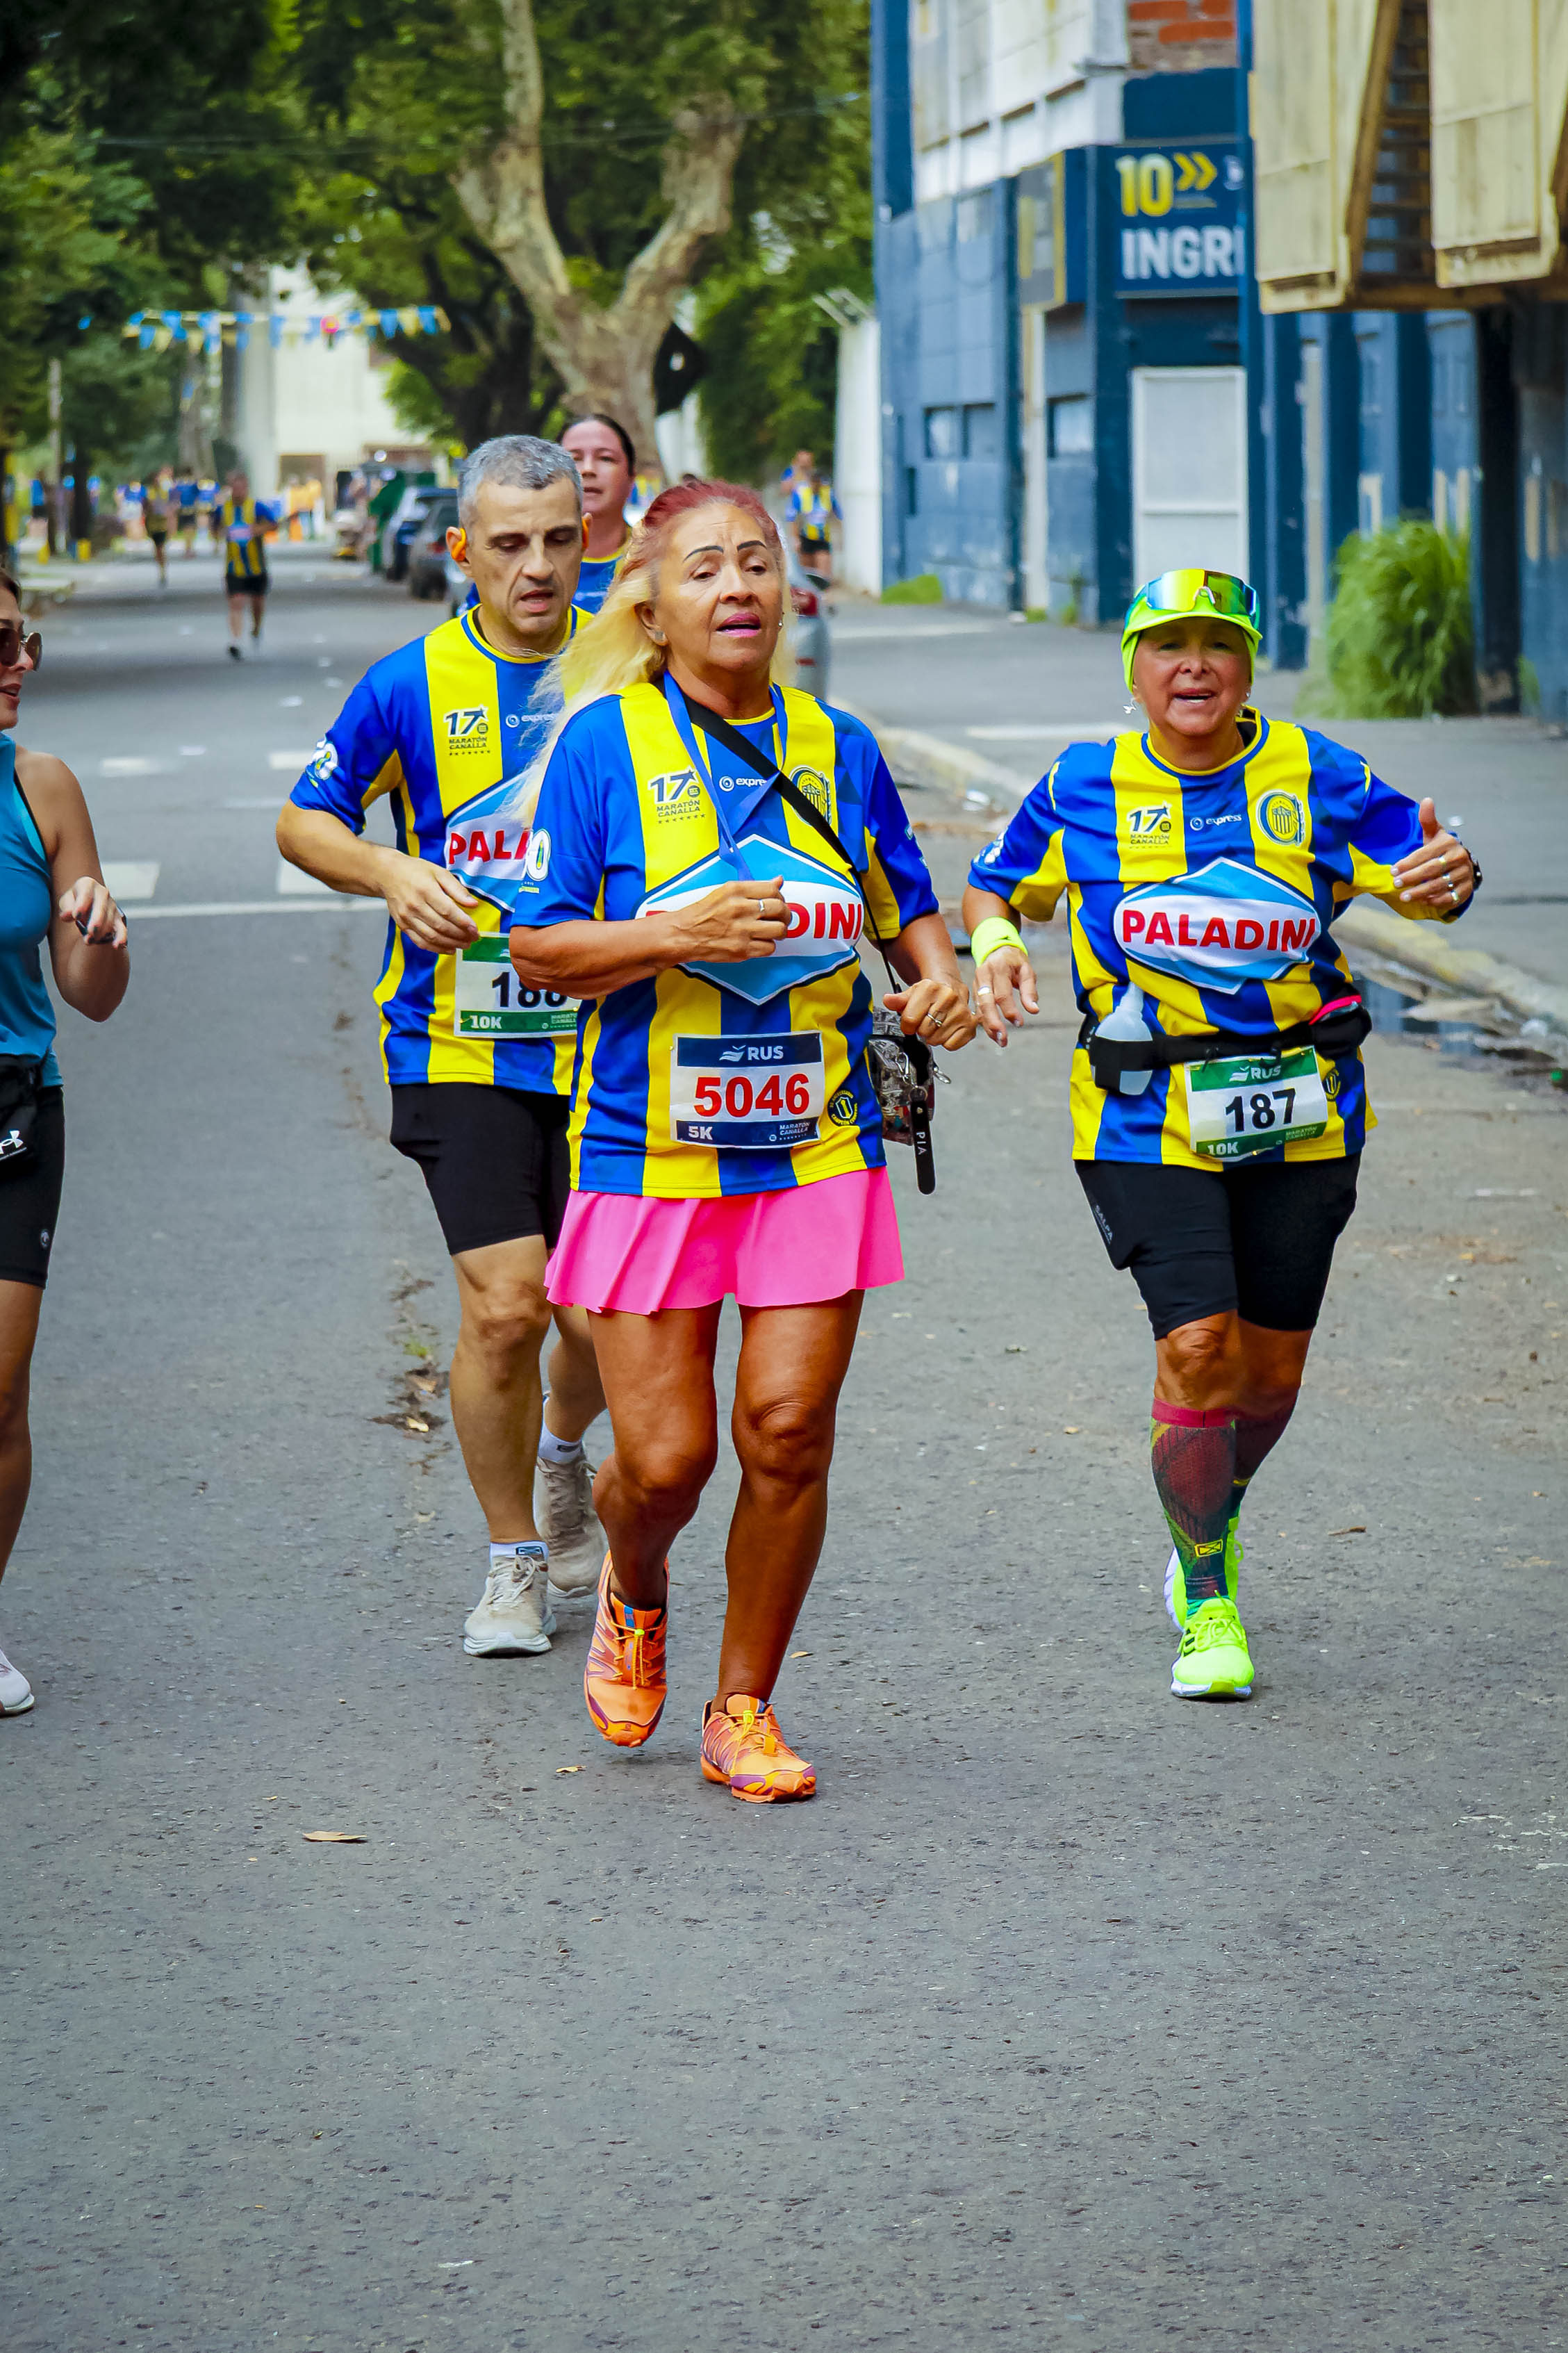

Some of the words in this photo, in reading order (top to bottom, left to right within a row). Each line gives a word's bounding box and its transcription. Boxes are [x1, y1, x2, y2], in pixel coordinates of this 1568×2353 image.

[443, 705, 488, 737] 17
[649, 769, 697, 803] 17
[736, 778, 767, 787] expre
[657, 800, 700, 812] MARATÓN
[658, 806, 700, 817] CANALLA
[1128, 803, 1169, 833] 17
[1205, 814, 1242, 826] express
[1123, 909, 1316, 952] PALADINI
[470, 1015, 502, 1029] 10K
[748, 1046, 784, 1061] RUS
[1251, 1065, 1282, 1079] RUS
[693, 1073, 809, 1117] 5046
[1225, 1088, 1296, 1132] 187
[688, 1126, 713, 1140] 5K
[916, 1131, 928, 1156] PIA
[1207, 1141, 1239, 1156] 10K
